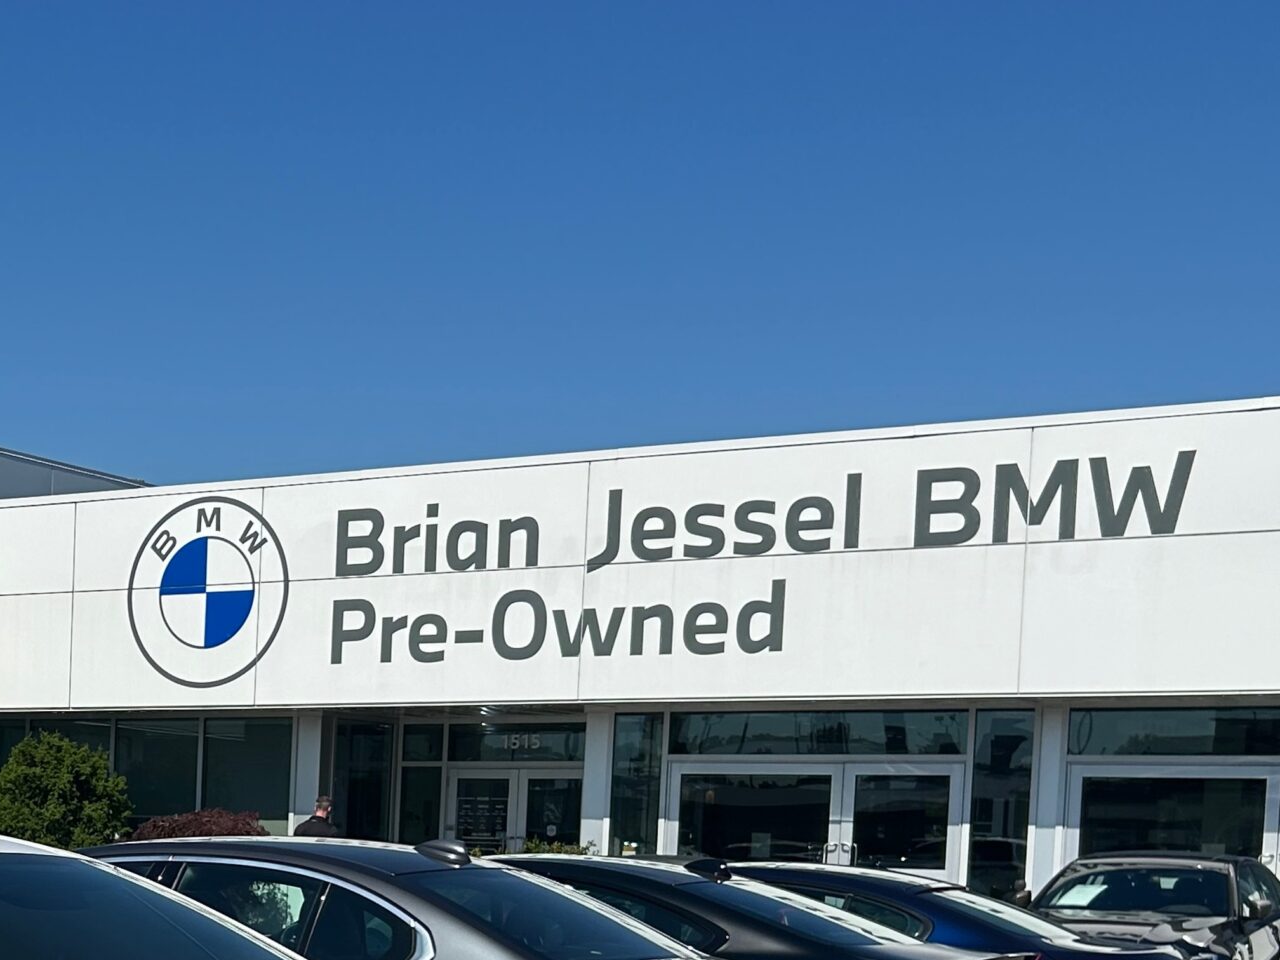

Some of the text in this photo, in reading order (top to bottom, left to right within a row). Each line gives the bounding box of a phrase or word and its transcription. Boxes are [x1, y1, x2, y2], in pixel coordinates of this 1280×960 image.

[150, 506, 268, 562] BMW
[335, 449, 1197, 577] Brian Jessel BMW
[330, 578, 787, 665] Pre-Owned
[503, 733, 541, 749] 1515
